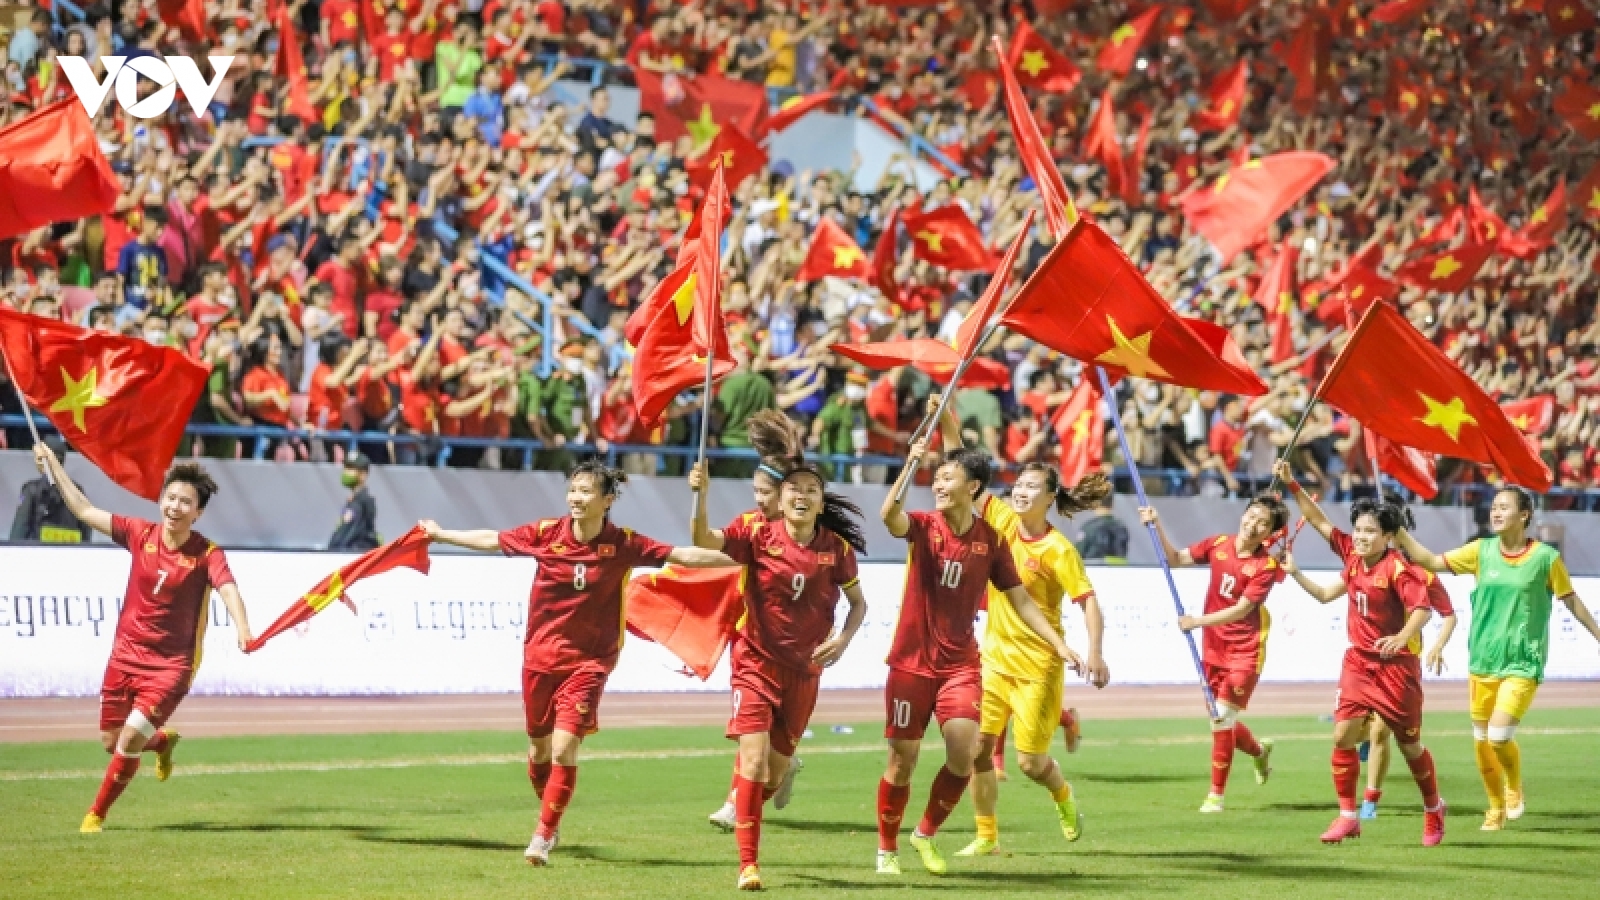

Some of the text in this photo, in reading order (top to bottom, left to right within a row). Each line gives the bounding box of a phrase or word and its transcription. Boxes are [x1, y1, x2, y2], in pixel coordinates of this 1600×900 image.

[153, 570, 168, 595] 7
[573, 563, 587, 590] 8
[791, 573, 806, 601] 9
[940, 559, 963, 589] 10
[1219, 571, 1236, 599] 12
[733, 689, 743, 719] 9
[892, 698, 911, 728] 10
